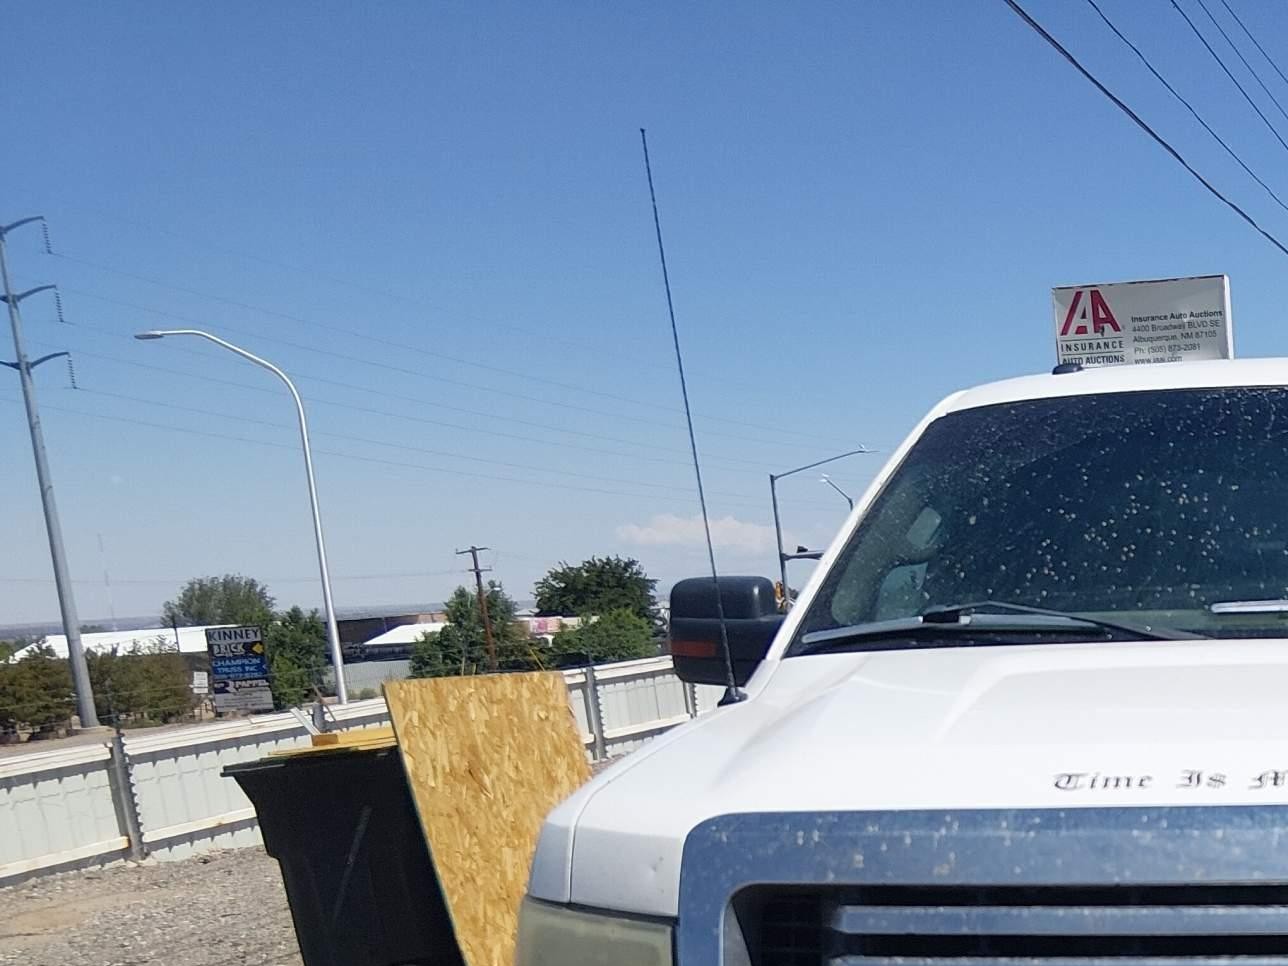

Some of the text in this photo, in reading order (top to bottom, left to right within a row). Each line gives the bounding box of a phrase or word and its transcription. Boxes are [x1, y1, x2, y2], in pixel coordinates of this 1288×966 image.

[1131, 309, 1223, 323] Insurance Auto Auctions
[1151, 322, 1186, 332] Broadway
[1187, 320, 1208, 328] BLVD
[1208, 319, 1221, 327] SE
[1180, 332, 1194, 340] NM
[1061, 340, 1124, 353] INSURANCE
[1062, 355, 1125, 366] AUTO AUCTIONS
[208, 629, 258, 641] KINNEY
[213, 643, 245, 655] BRICK
[1053, 771, 1153, 790] Time
[1176, 769, 1227, 788] Is
